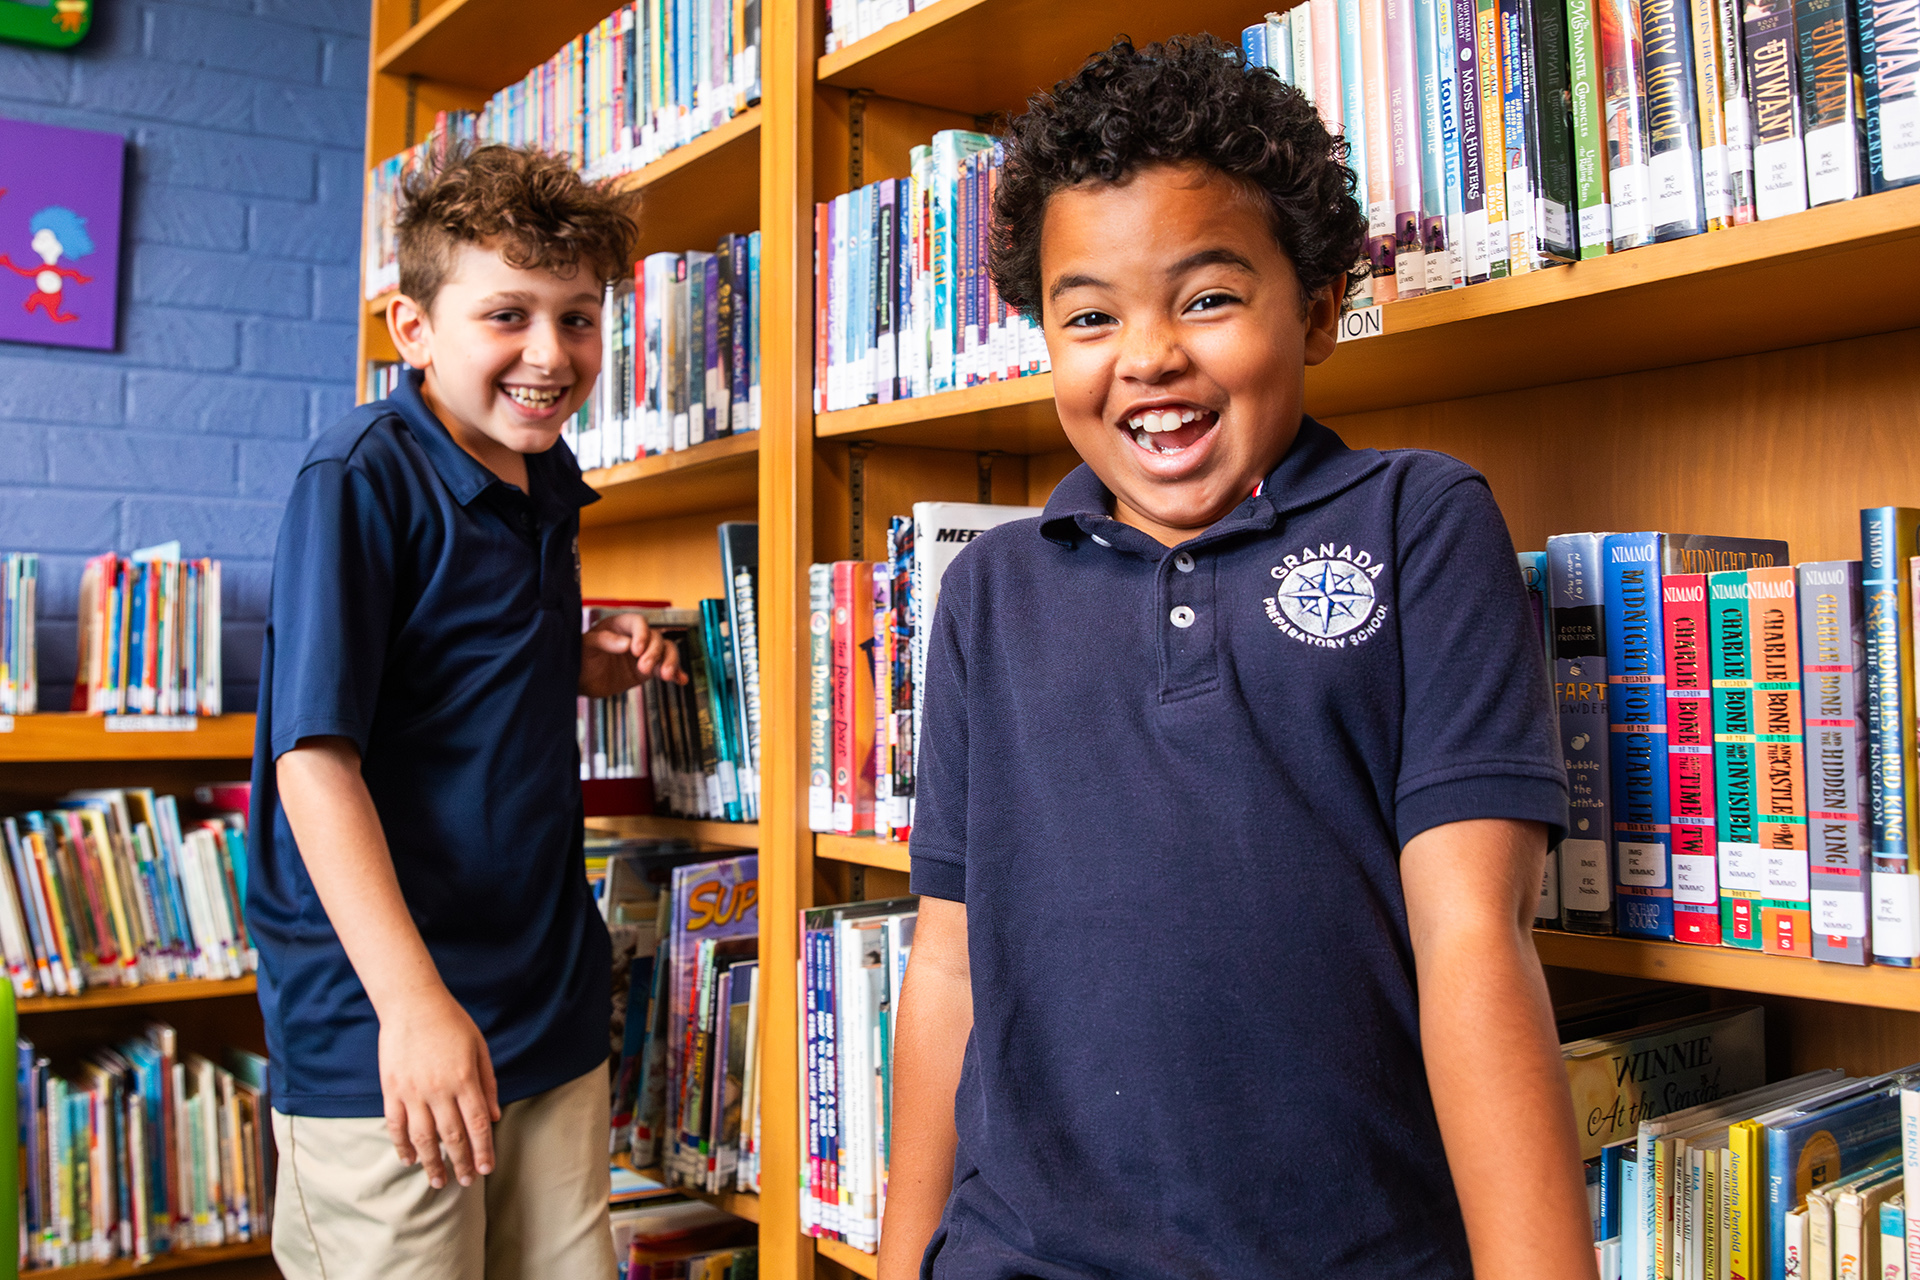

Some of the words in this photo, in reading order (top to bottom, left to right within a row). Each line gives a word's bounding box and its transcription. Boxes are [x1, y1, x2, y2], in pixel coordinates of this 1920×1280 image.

[1463, 0, 1472, 42] IGHTMARE
[1479, 15, 1488, 49] ROAD
[1501, 11, 1511, 56] CAMPFIRE
[1509, 14, 1517, 31] THE
[1487, 18, 1497, 60] INVASION
[1510, 31, 1518, 57] CURSE
[1702, 39, 1711, 63] THE
[1800, 30, 1815, 82] ISLAND
[1873, 0, 1920, 98] NWAN
[1424, 72, 1434, 91] THE
[1481, 52, 1491, 102] WEENIES
[1489, 63, 1497, 76] OF
[1511, 58, 1519, 70] OF
[1512, 70, 1520, 87] THE
[1864, 64, 1878, 84] OF
[1392, 87, 1402, 107] THE
[1704, 63, 1716, 104] GRAIN
[1425, 93, 1436, 116] LAST
[1462, 68, 1475, 139] MONSTER
[1646, 61, 1682, 143] HOLLOW
[1392, 108, 1404, 136] SILVER
[1426, 118, 1436, 155] BATTLE
[1866, 94, 1883, 175] LEGENDS
[1394, 137, 1405, 167] CHAIR
[1466, 135, 1480, 200] HUNTERS
[1487, 184, 1496, 216] LUBAR
[1495, 182, 1504, 213] DAVID
[1341, 309, 1380, 338] ION
[1270, 542, 1384, 579] GRANADA
[1611, 544, 1655, 564] NIMMO
[1680, 548, 1747, 574] MIDNIGHT
[1750, 552, 1775, 567] FOR
[1869, 520, 1882, 569] NIMMO
[1663, 585, 1704, 603] NIMMO
[1712, 584, 1749, 600] NIMMO
[1748, 580, 1794, 599] NIMMO
[1805, 569, 1844, 586] NIMMO
[1263, 597, 1346, 649] PREPARATORY
[1349, 604, 1389, 646] SCHOOL
[1621, 569, 1650, 675] MIDNIGHT
[1816, 594, 1840, 663] CHARLIE
[1675, 617, 1699, 688] CHARLIE
[1721, 608, 1745, 678] CHARLIE
[1762, 609, 1788, 681] CHARLIE
[1867, 636, 1878, 665] THE
[811, 664, 829, 706] DOLL
[1554, 682, 1609, 700] FART
[1759, 682, 1792, 690] CHILDREN
[1877, 617, 1898, 732] CHRONICLES
[1556, 702, 1609, 714] OWDER
[1624, 685, 1651, 724] FOR
[1724, 690, 1747, 733] BONE
[1767, 692, 1790, 734] BONE
[1819, 674, 1841, 717] BONE
[1868, 674, 1880, 739] SECRET
[811, 708, 829, 764] PEOPLE
[1677, 700, 1700, 745] BONE
[1821, 731, 1831, 746] THE
[1833, 731, 1842, 746] AND
[1565, 760, 1600, 771] Bubble
[1679, 756, 1689, 771] THE
[1690, 756, 1700, 771] AND
[1726, 744, 1736, 759] THE
[1736, 744, 1747, 759] AND
[1768, 744, 1778, 761] THE
[1780, 744, 1792, 760] AND
[1577, 773, 1588, 781] in
[1625, 733, 1653, 823] CHARLIE
[1769, 759, 1793, 815] CASTLE
[1821, 748, 1848, 809] HIDDEN
[1870, 743, 1883, 826] KINGDOM
[1882, 753, 1901, 790] RED
[1568, 798, 1604, 808] athtub
[1574, 784, 1592, 795] the
[1679, 772, 1702, 816] TIME
[1728, 761, 1752, 843] INVISIBLE
[1781, 816, 1798, 824] KING
[1883, 795, 1904, 842] KING
[1823, 823, 1849, 864] KING
[686, 880, 758, 932] SUP
[1626, 903, 1660, 917] ORCHARD
[1628, 915, 1659, 930] BOOKS
[1612, 1036, 1713, 1088] WINNIE
[1587, 1094, 1626, 1137] At
[1630, 1090, 1655, 1124] the
[1661, 1066, 1728, 1114] Seasid
[1906, 1115, 1919, 1168] PERKINS
[1655, 1160, 1664, 1186] HOW
[1692, 1165, 1700, 1191] ELLA
[1731, 1151, 1741, 1206] Alexandra
[1770, 1175, 1782, 1203] Penn
[1683, 1173, 1691, 1210] PAMELA
[1656, 1187, 1664, 1234] DROOFUS
[1683, 1210, 1691, 1242] CAMEL
[1656, 1237, 1664, 1257] THE
[1731, 1209, 1741, 1252] Penfold
